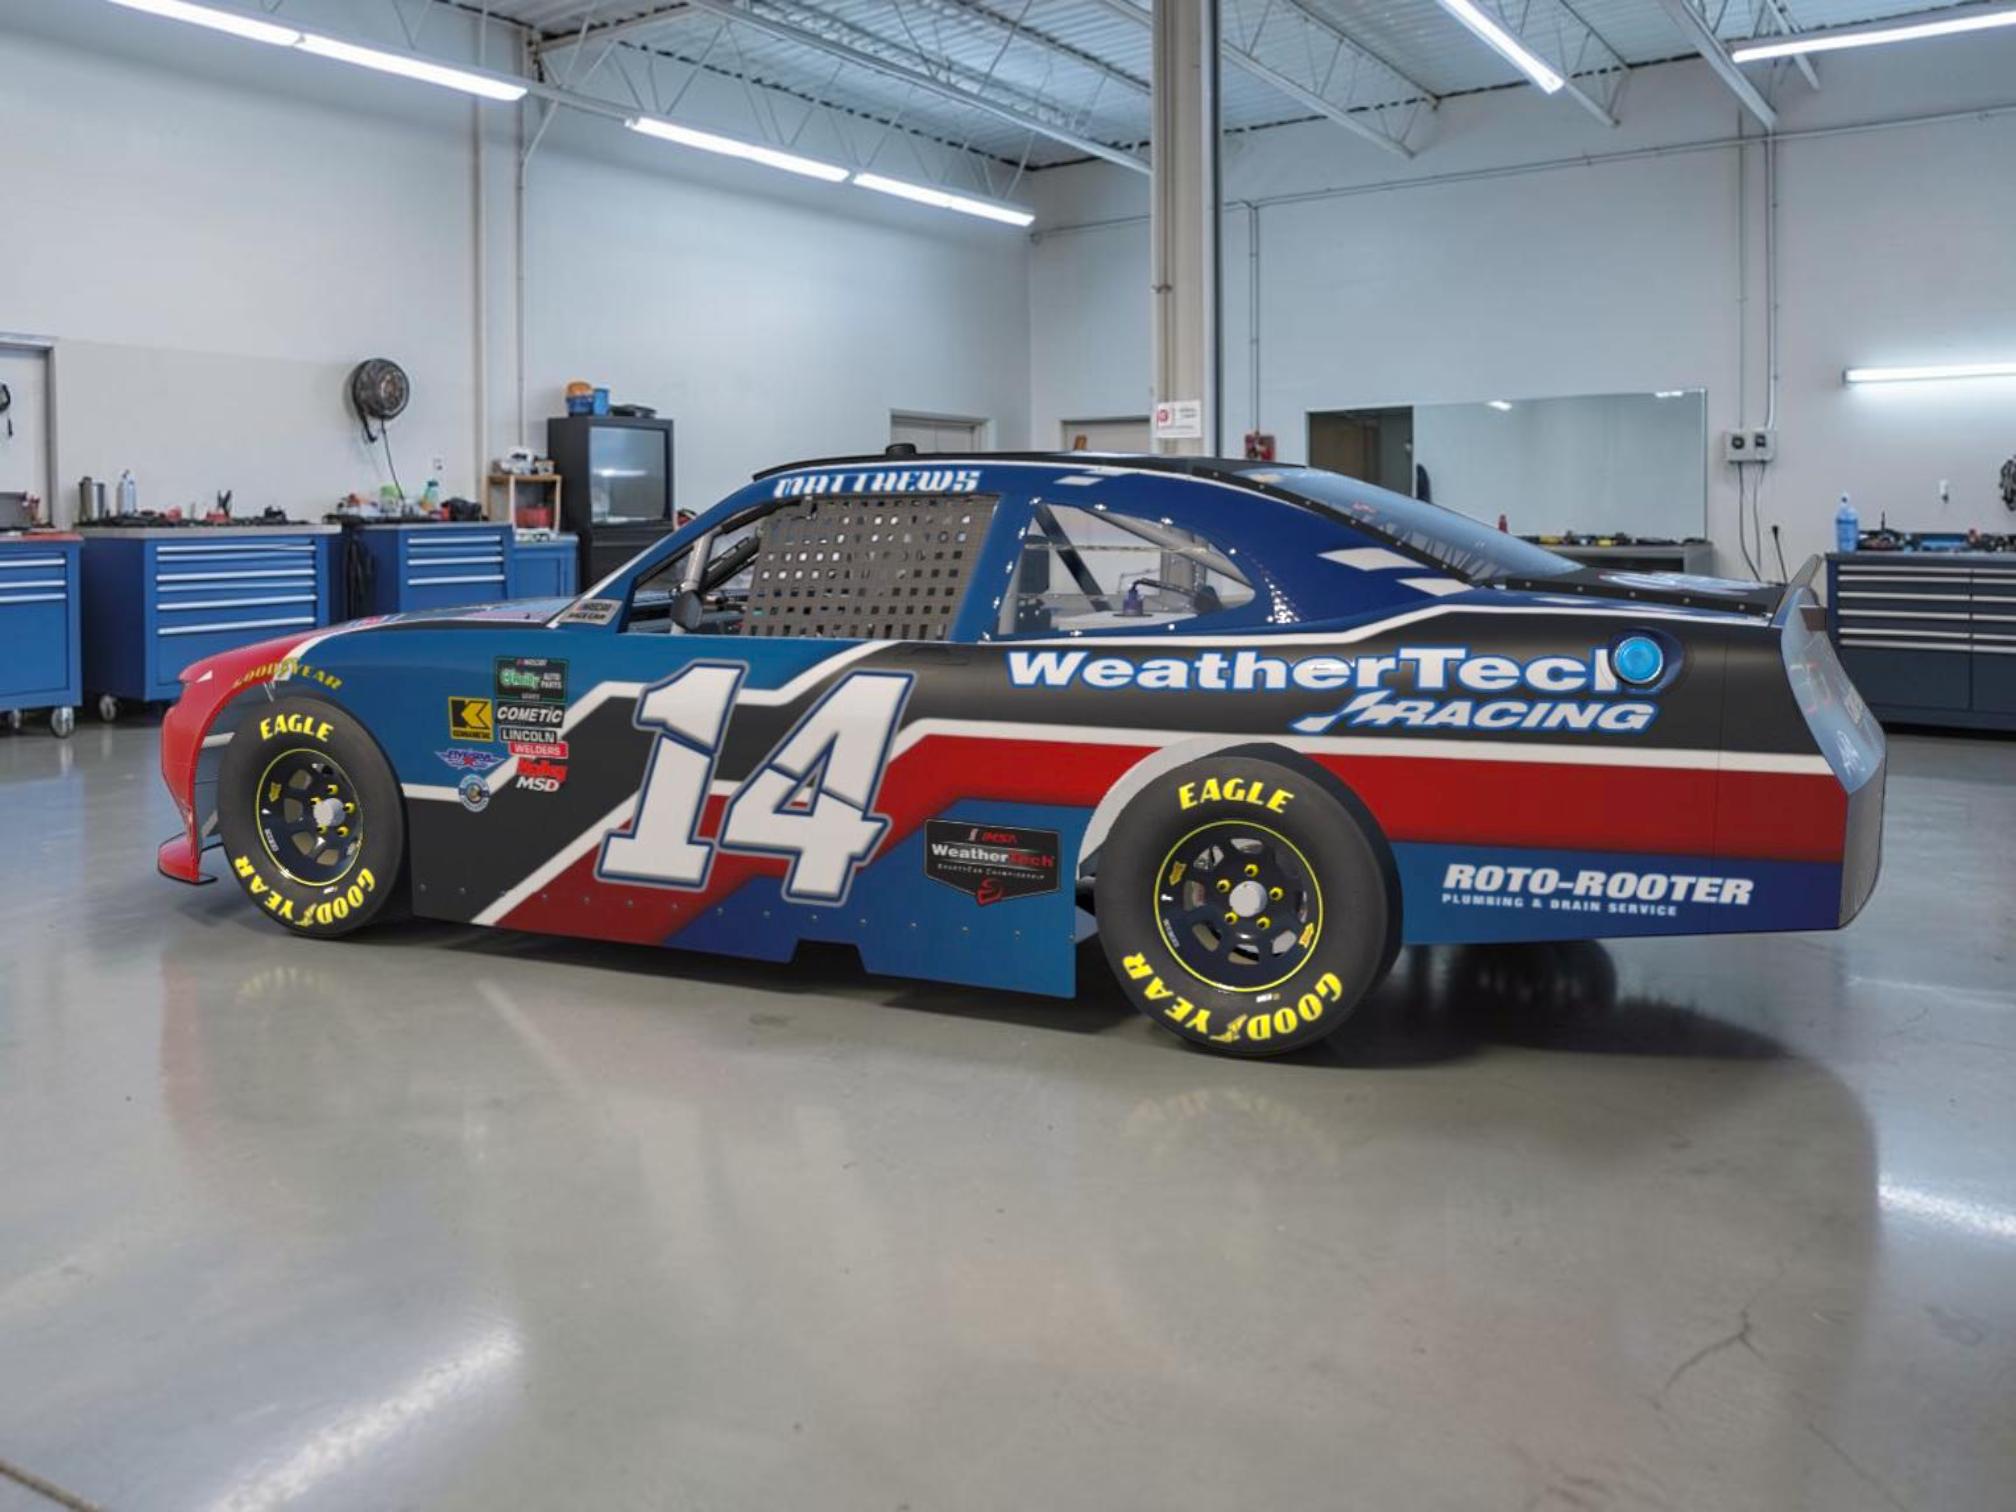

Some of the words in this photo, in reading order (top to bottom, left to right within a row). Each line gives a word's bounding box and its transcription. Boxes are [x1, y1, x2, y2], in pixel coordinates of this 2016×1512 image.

[773, 469, 983, 498] MATTHEWS
[260, 714, 334, 742] EAGLE
[496, 706, 564, 724] COMETIC
[1387, 697, 1657, 732] RACING
[502, 728, 556, 743] LINCOLN
[513, 743, 562, 756] WELDERS
[516, 776, 560, 793] MSD
[594, 659, 917, 907] 14
[1178, 778, 1295, 814] EAGLE
[234, 855, 376, 928] GOODYEAR
[1442, 863, 1755, 906] ROTO-ROOTER
[1441, 893, 1524, 908] PLUMBING
[1532, 897, 1542, 909] &
[1550, 899, 1600, 912] DRAIN
[1607, 902, 1677, 917] SERVICE
[1121, 952, 1343, 1043] GOODYEAR
